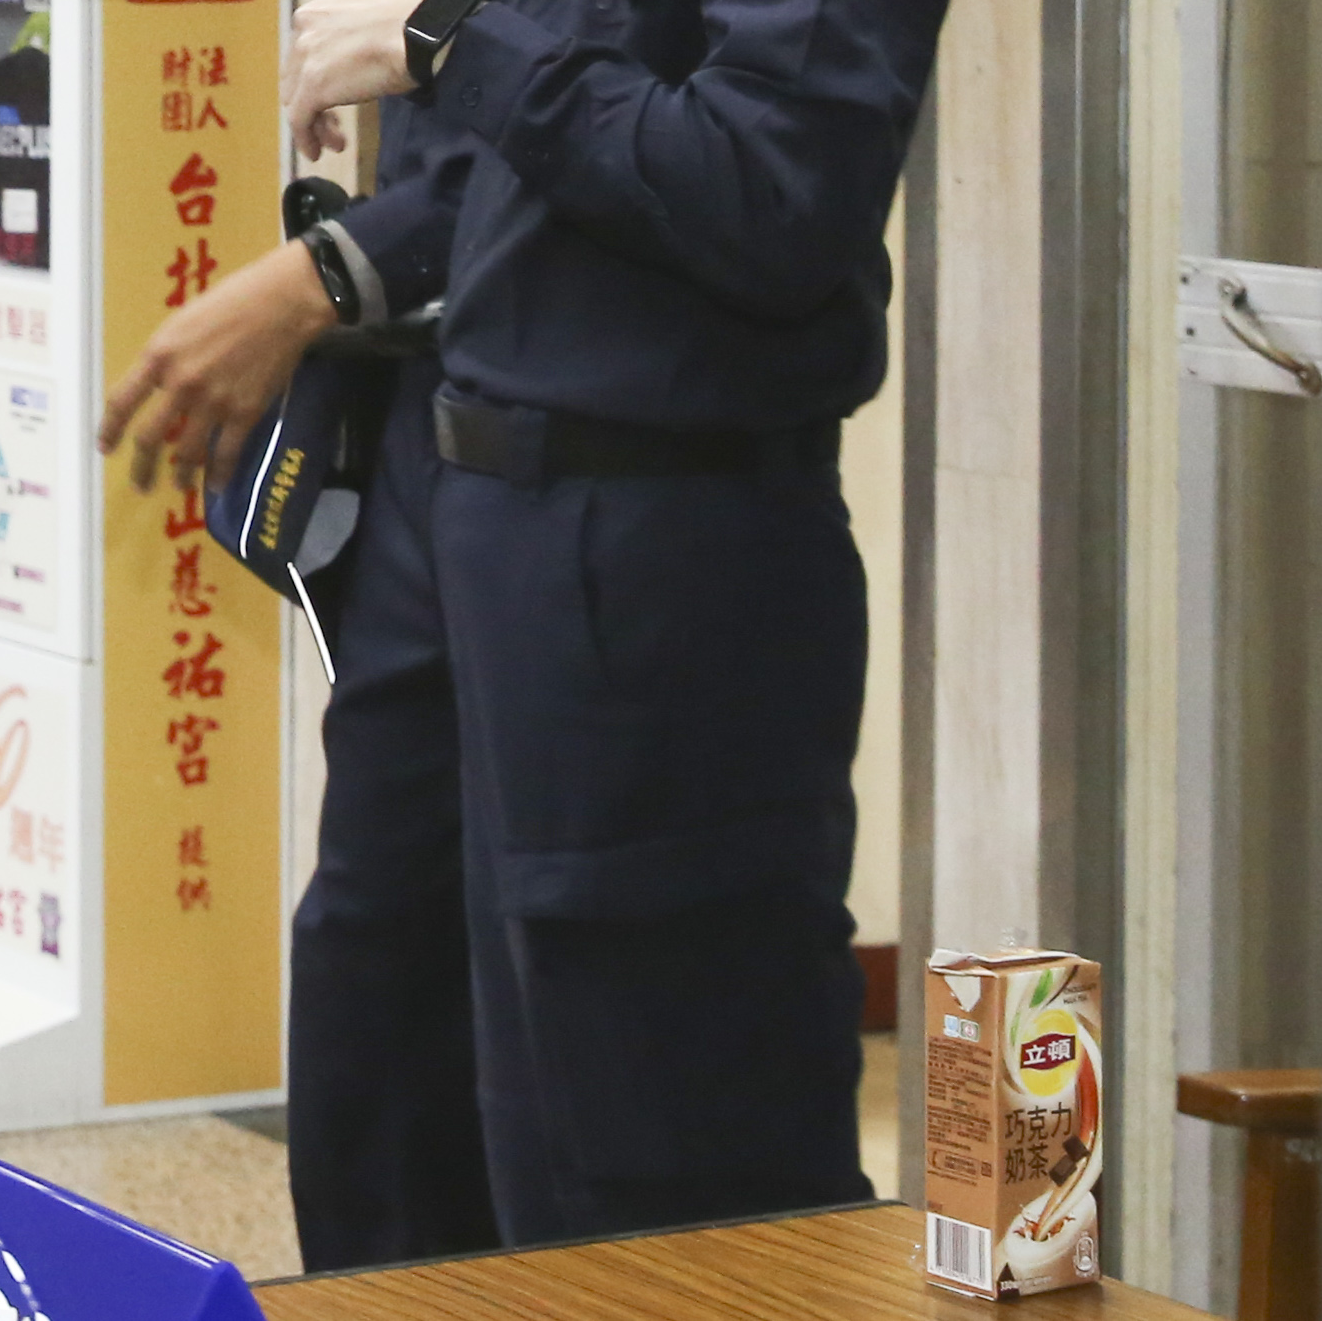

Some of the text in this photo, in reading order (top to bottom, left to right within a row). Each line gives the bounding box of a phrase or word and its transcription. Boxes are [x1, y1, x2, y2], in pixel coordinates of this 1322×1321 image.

[1023, 1038, 1071, 1065] 立頓
[1005, 1102, 1074, 1142] 巧克力
[1005, 1145, 1049, 1184] 奶茶
